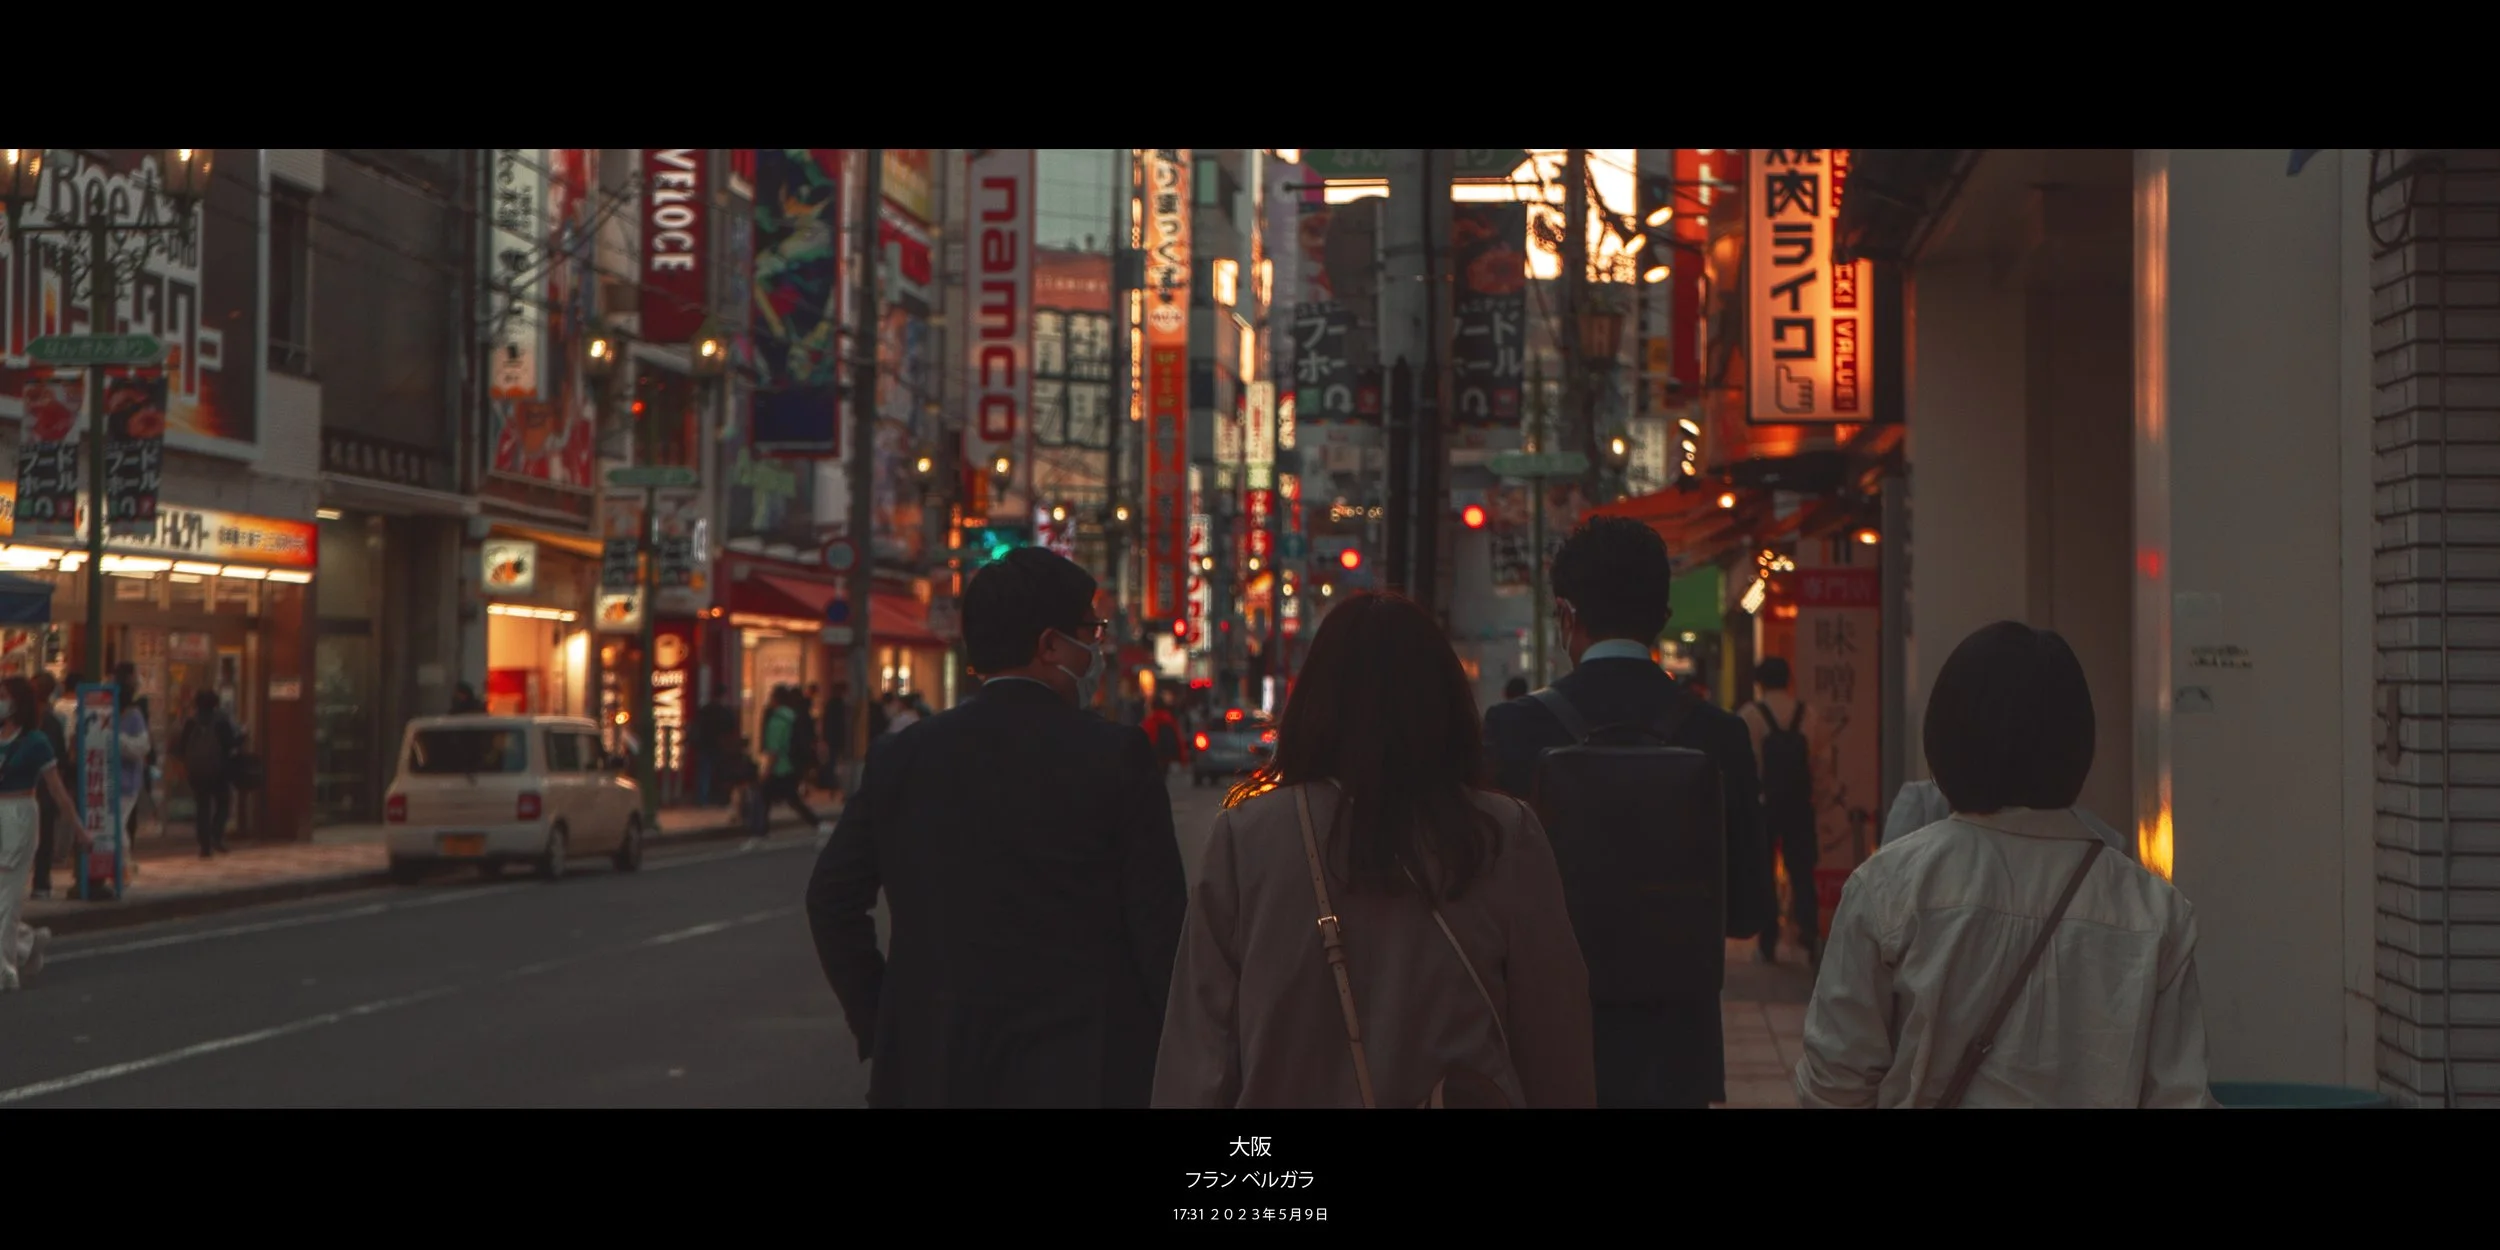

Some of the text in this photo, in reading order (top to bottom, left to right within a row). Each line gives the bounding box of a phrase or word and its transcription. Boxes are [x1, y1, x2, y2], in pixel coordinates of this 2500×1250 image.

[652, 149, 695, 272] VELOCE
[979, 176, 1018, 443] namco
[1297, 315, 1347, 349] フー
[1297, 351, 1347, 383] ホー
[20, 446, 75, 474] フード
[106, 445, 158, 474] フード
[19, 470, 78, 496] ホール
[106, 470, 161, 495] ホール
